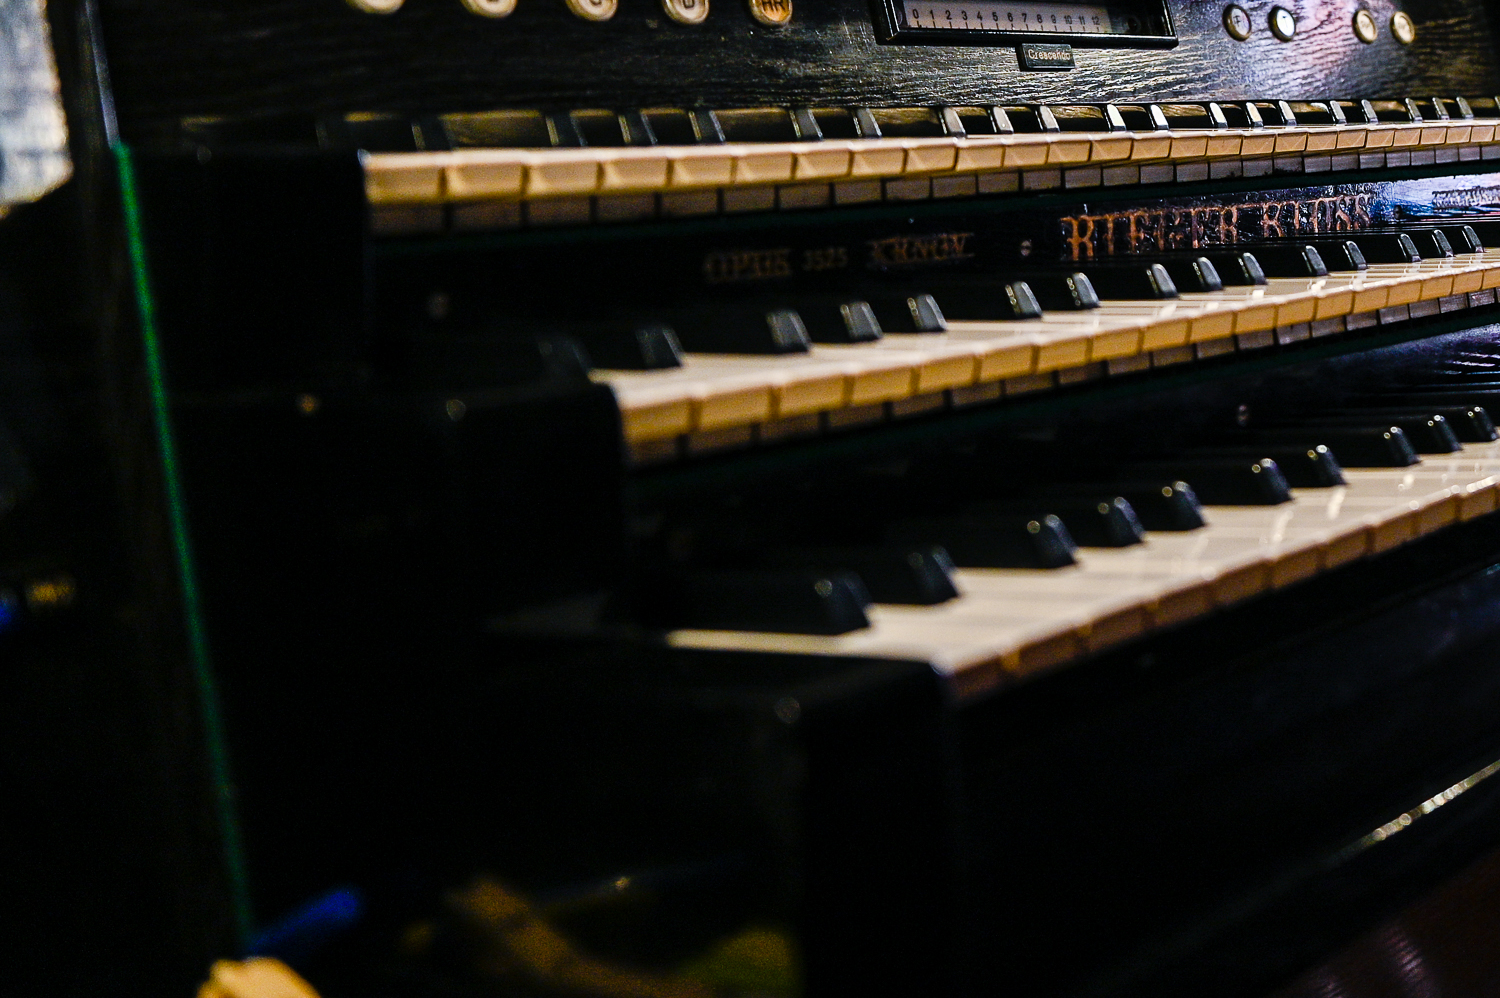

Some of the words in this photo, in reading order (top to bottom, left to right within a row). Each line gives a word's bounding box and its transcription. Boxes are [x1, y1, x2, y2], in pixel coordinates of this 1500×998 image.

[912, 8, 919, 20] 0
[929, 9, 935, 20] 1
[945, 10, 952, 20] 2
[961, 10, 968, 21] 3
[976, 11, 983, 21] 4
[991, 11, 998, 22] 5
[1007, 12, 1013, 22] 6
[1021, 13, 1028, 23] 7
[1036, 13, 1043, 23] 8
[1050, 14, 1056, 24] 9
[1064, 14, 1073, 25] 10
[1079, 15, 1086, 25] 11
[1091, 15, 1100, 26] 12
[1027, 48, 1071, 61] Crescendo
[1060, 205, 1239, 260] RIEGER
[866, 232, 976, 270] KRNOV
